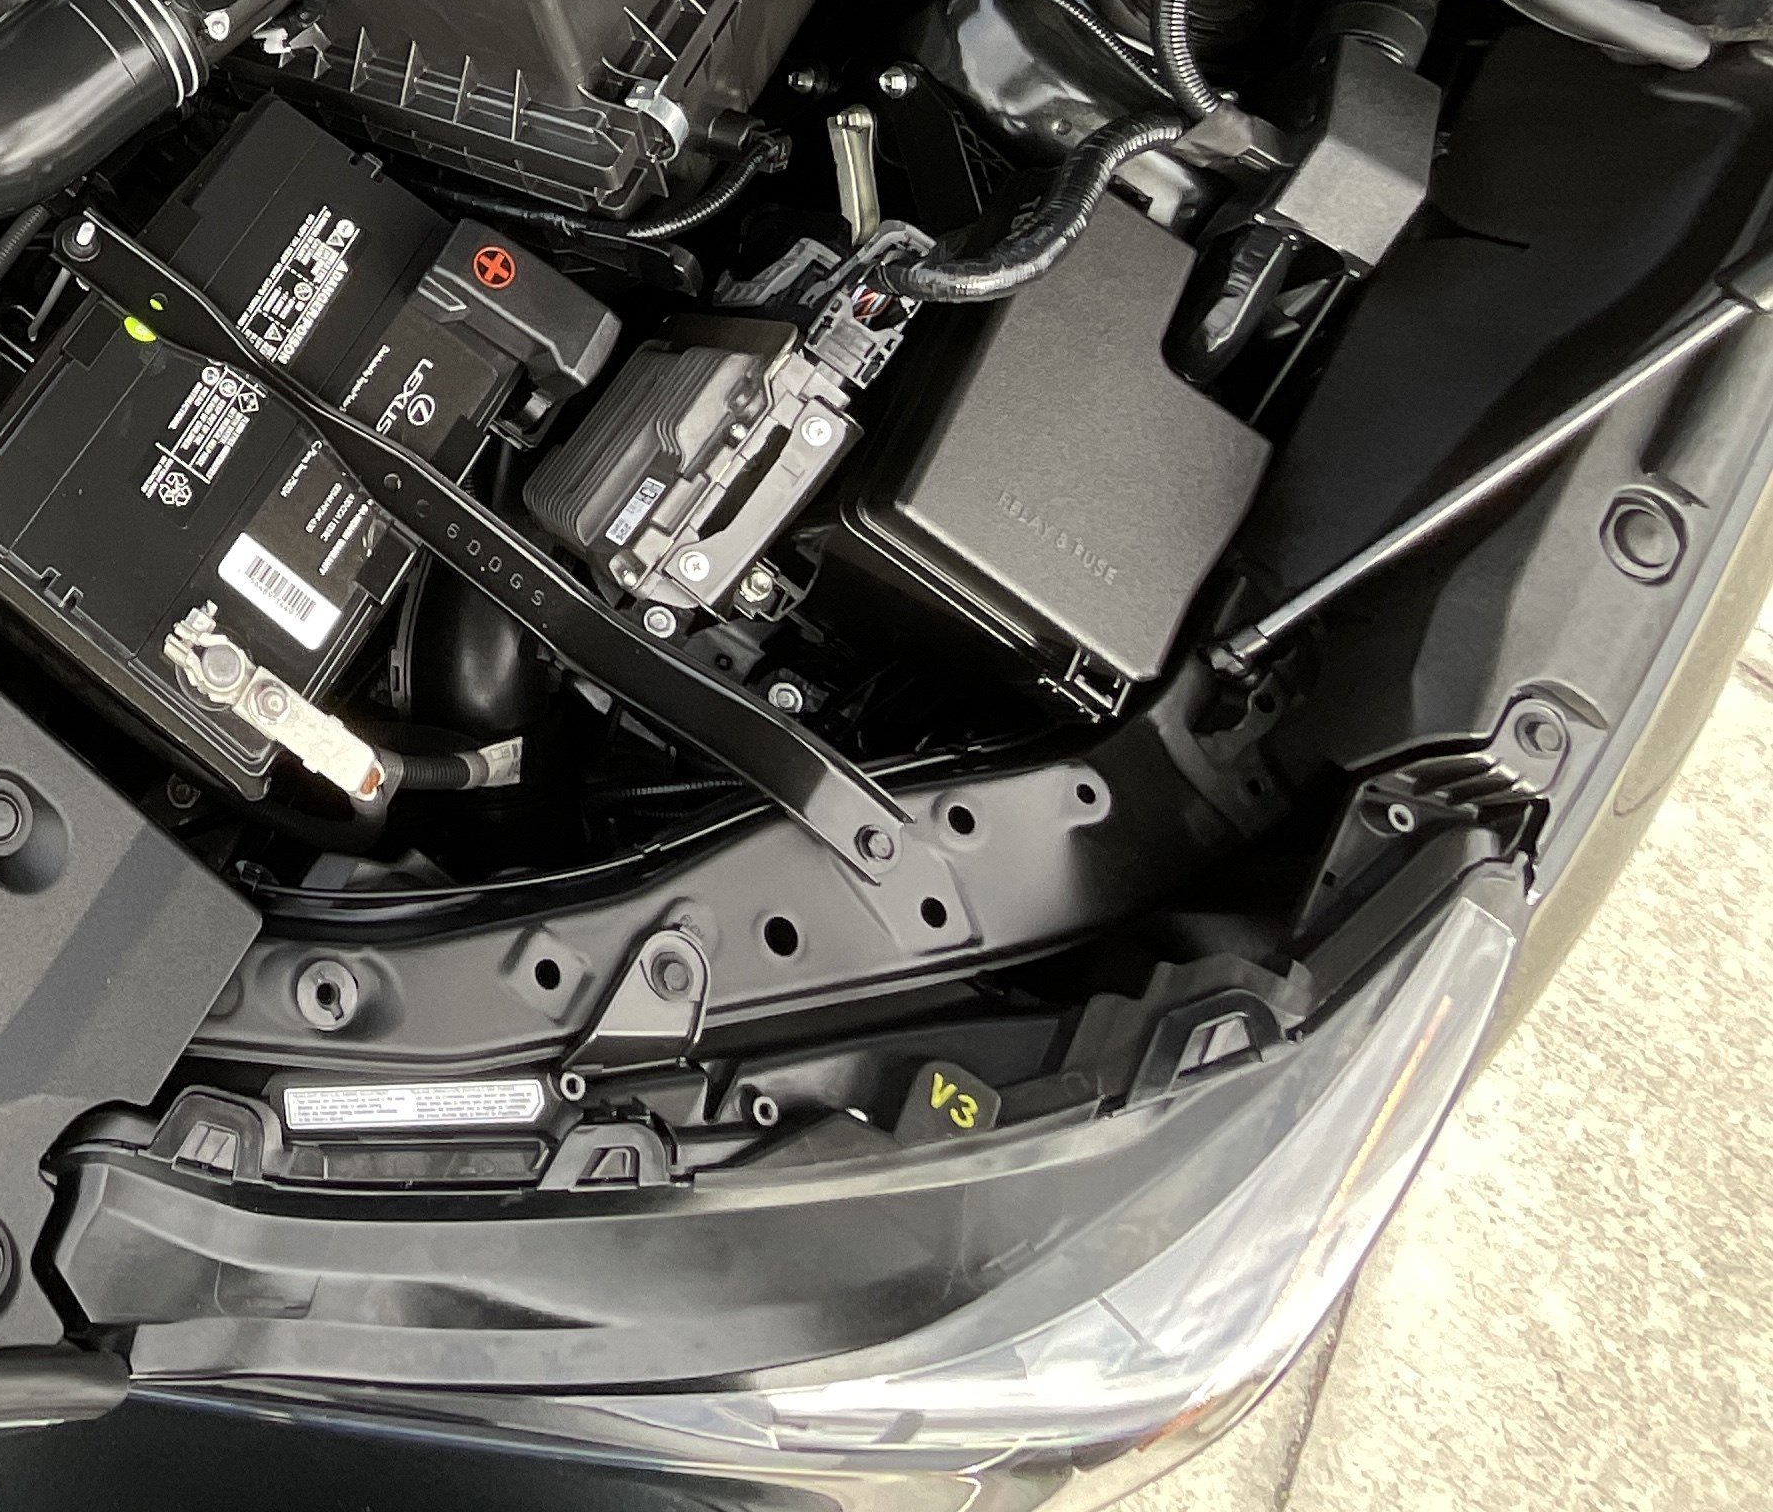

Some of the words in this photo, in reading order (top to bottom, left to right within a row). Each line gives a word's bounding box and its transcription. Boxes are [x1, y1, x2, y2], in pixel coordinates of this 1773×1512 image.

[276, 269, 344, 364] DANGER/POISON
[373, 356, 434, 436] LEXUS
[931, 1072, 979, 1128] V3
